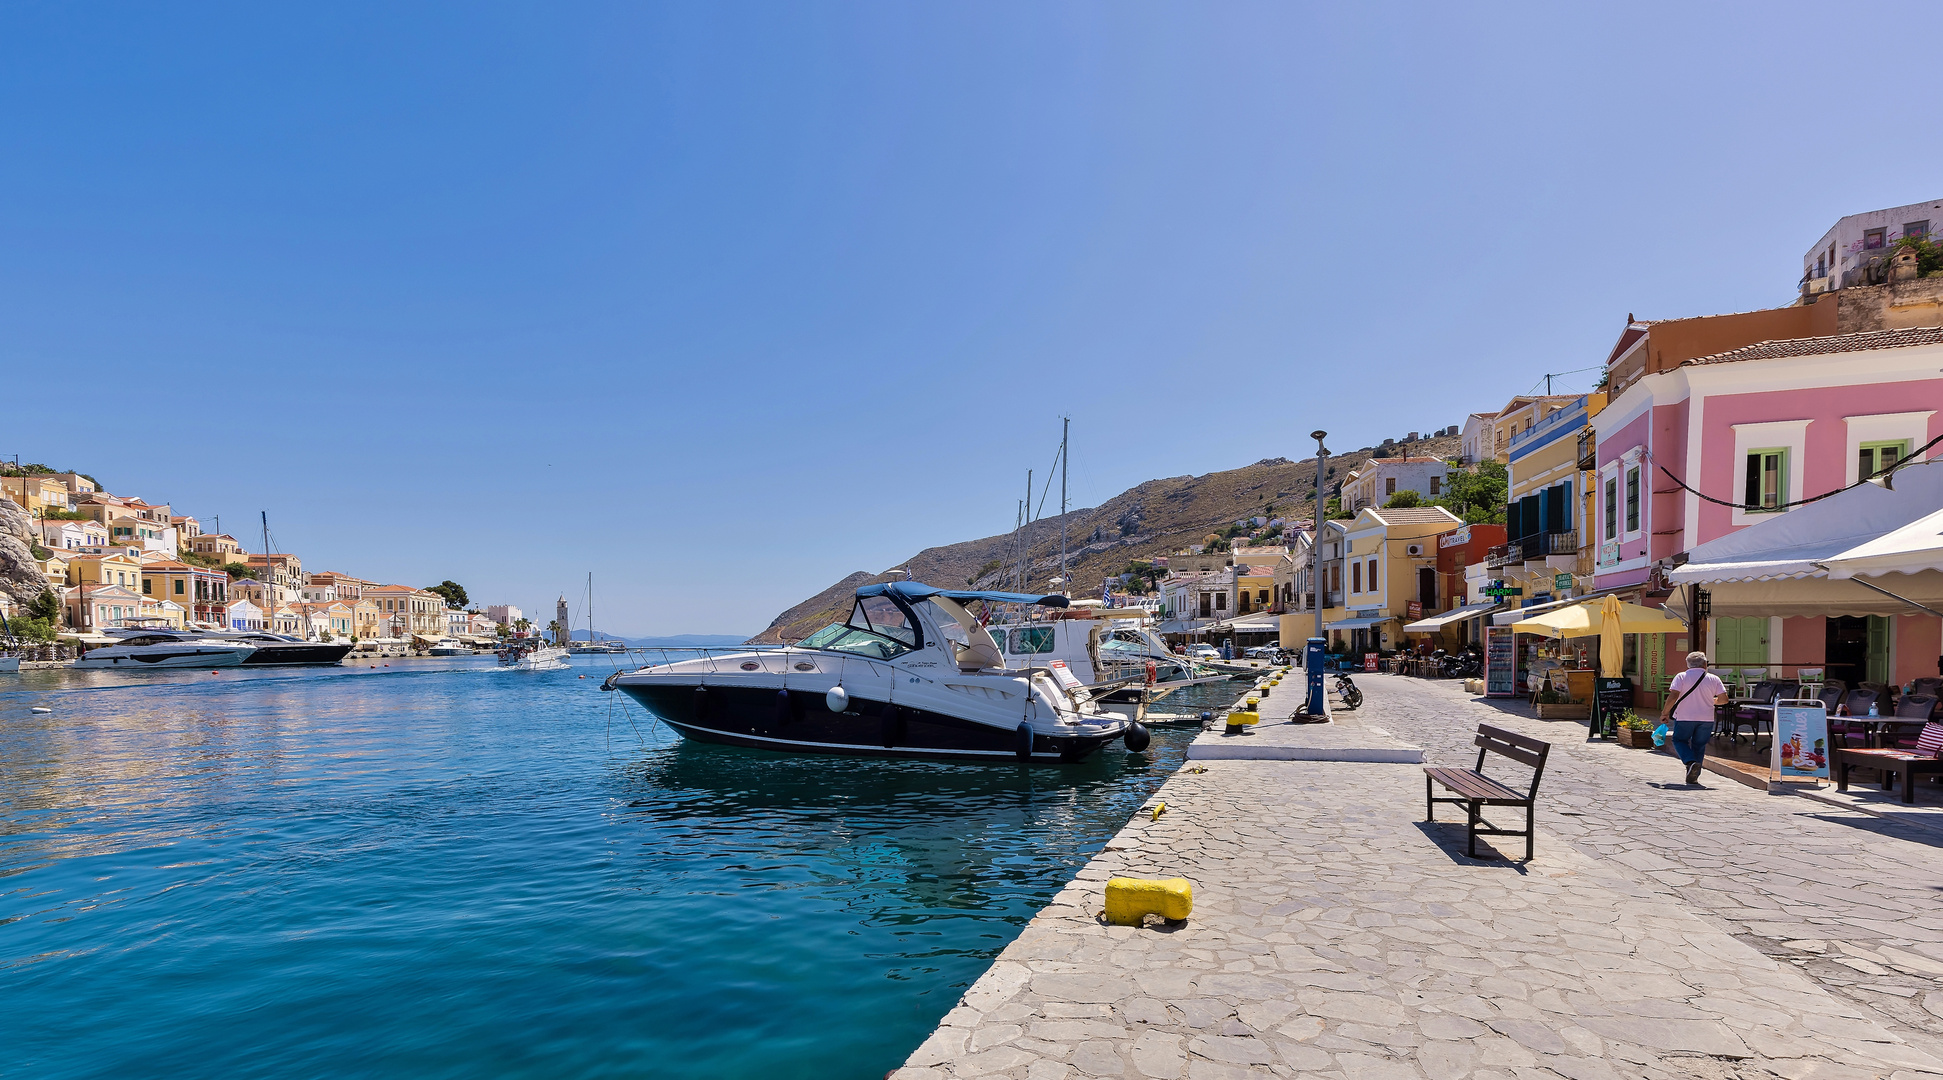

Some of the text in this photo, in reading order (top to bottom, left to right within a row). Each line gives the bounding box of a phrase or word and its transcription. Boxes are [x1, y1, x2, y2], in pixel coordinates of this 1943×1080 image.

[1450, 535, 1465, 543] TRAVEL
[1486, 588, 1512, 596] HARM
[1791, 711, 1816, 767] Smoothies
